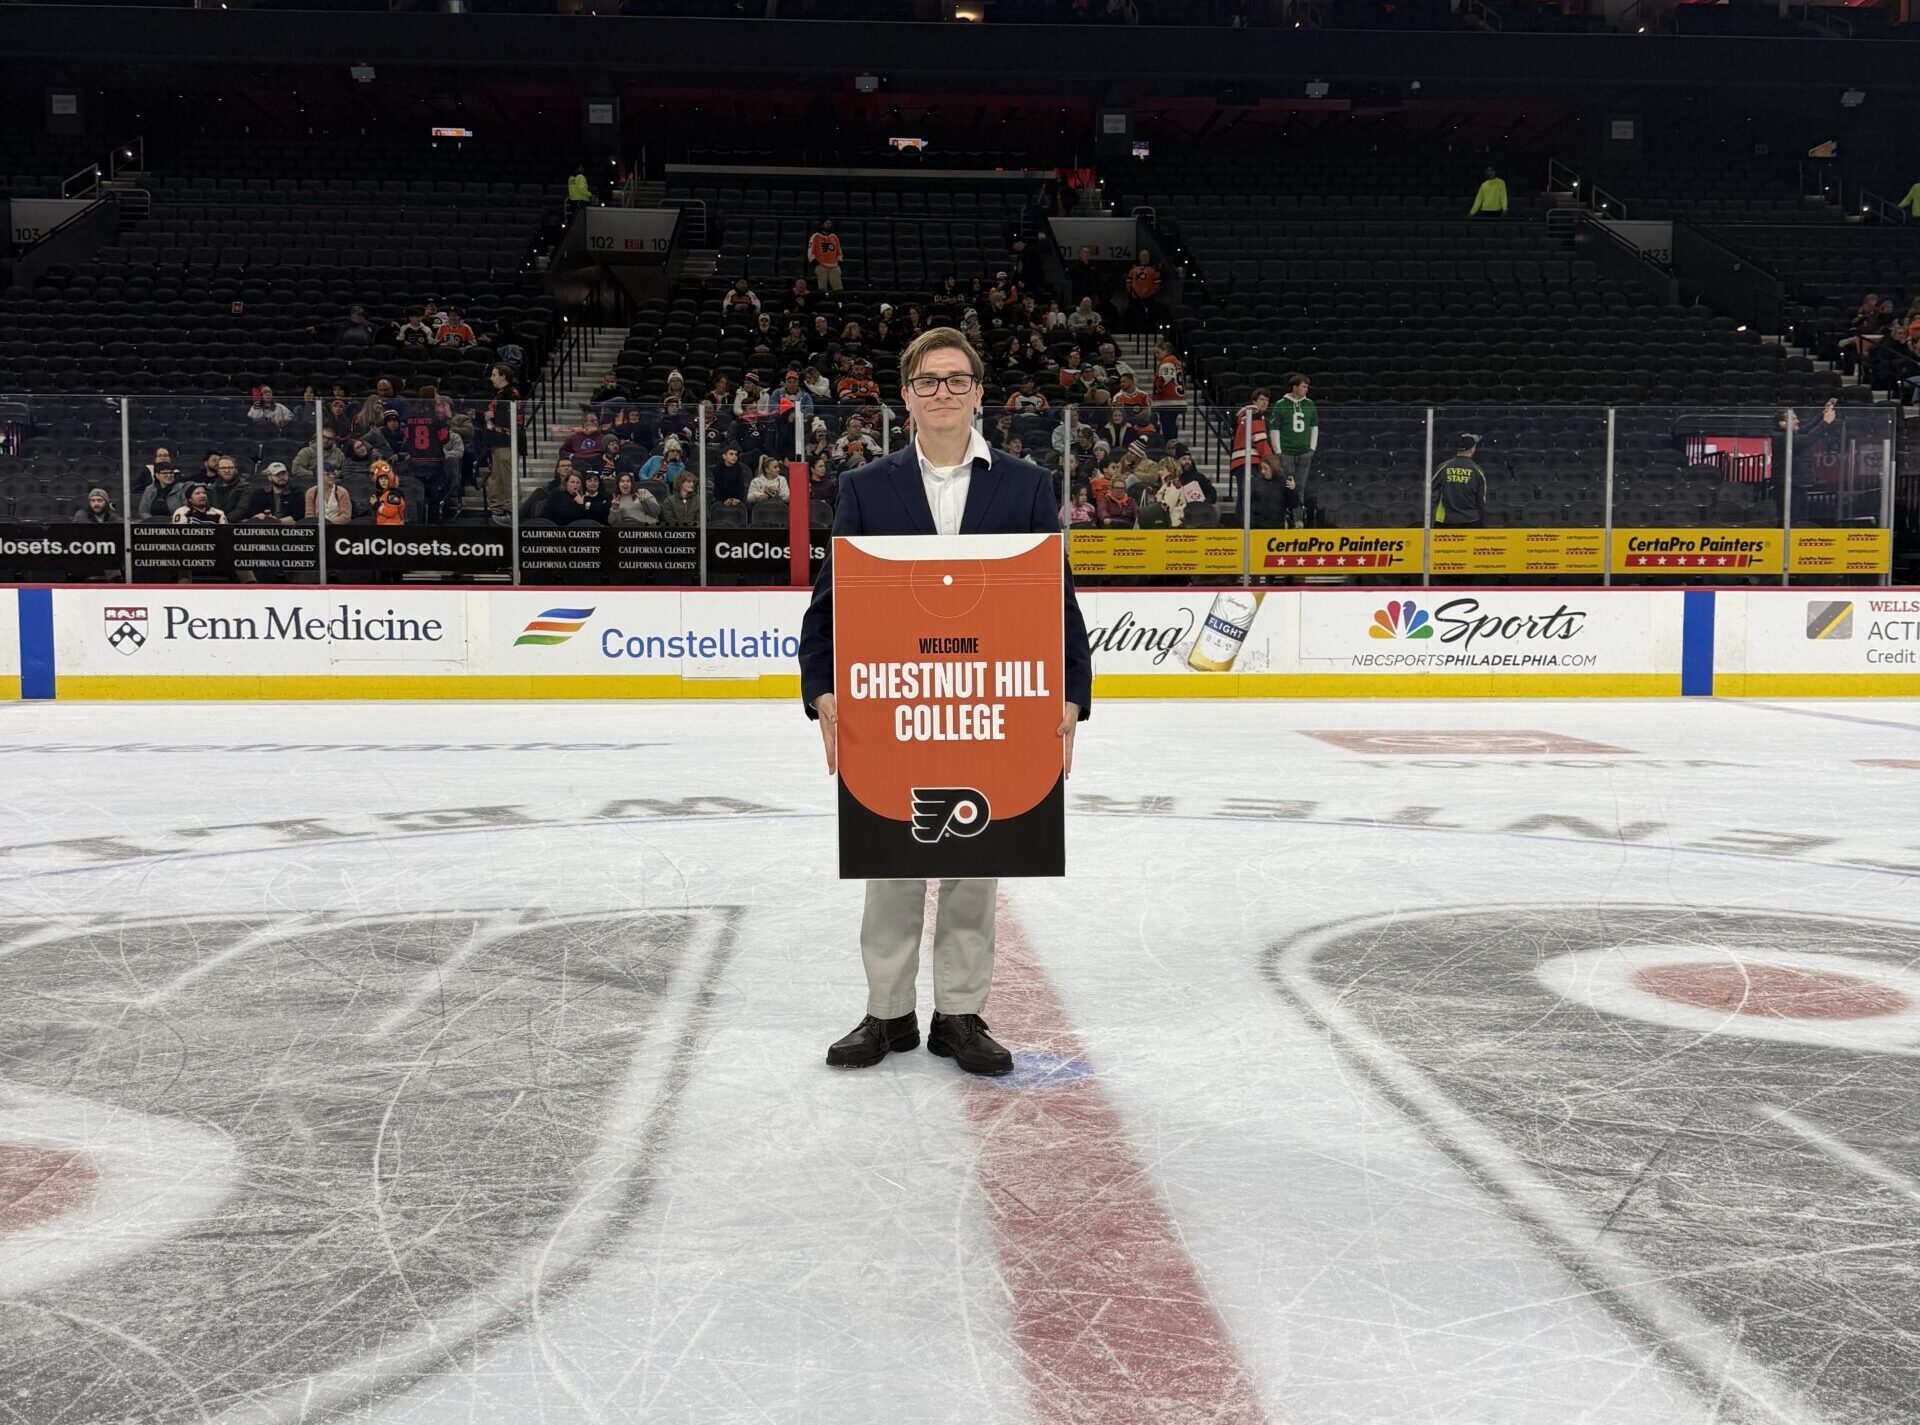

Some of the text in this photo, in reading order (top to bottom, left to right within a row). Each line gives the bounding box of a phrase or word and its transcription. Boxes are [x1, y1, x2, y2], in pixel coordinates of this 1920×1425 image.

[590, 237, 614, 249] 102
[1109, 246, 1131, 258] 124
[1292, 412, 1305, 433] 6
[414, 425, 430, 450] 8
[1446, 467, 1473, 477] EVENT
[1446, 475, 1471, 484] STAFF
[134, 528, 180, 536] CALIFORNIA
[234, 528, 279, 537] CALIFORNIA
[522, 530, 567, 538] CALIFORNIA
[618, 531, 662, 539] CALIFORNIA
[134, 543, 180, 551] CALIFORNIA
[234, 544, 280, 552] CALIFORNIA
[335, 538, 503, 556] CalClosets.com
[522, 546, 567, 554] CALIFORNIA
[619, 546, 662, 554] CALIFORNIA
[1266, 536, 1336, 552] CertaPro
[1628, 536, 1697, 552] CertaPro
[135, 559, 181, 567] CALIFORNIA
[234, 559, 280, 567] CALIFORNIA
[522, 561, 567, 569] CALIFORNIA
[619, 561, 662, 569] CALIFORNIA
[1869, 600, 1920, 613] WELLS
[164, 605, 442, 641] Penn Medicine
[1208, 617, 1244, 639] FLIGHT
[1434, 597, 1587, 652] Sports
[918, 637, 979, 654] WELCOME
[1351, 654, 1597, 667] NBCSPORTSPHILADELPHIA.COM
[1866, 648, 1917, 663] Credit
[850, 661, 1050, 699] CHESTNUT HILL
[895, 704, 1006, 741] COLLEGE
[1339, 758, 1764, 769] TOYOTA
